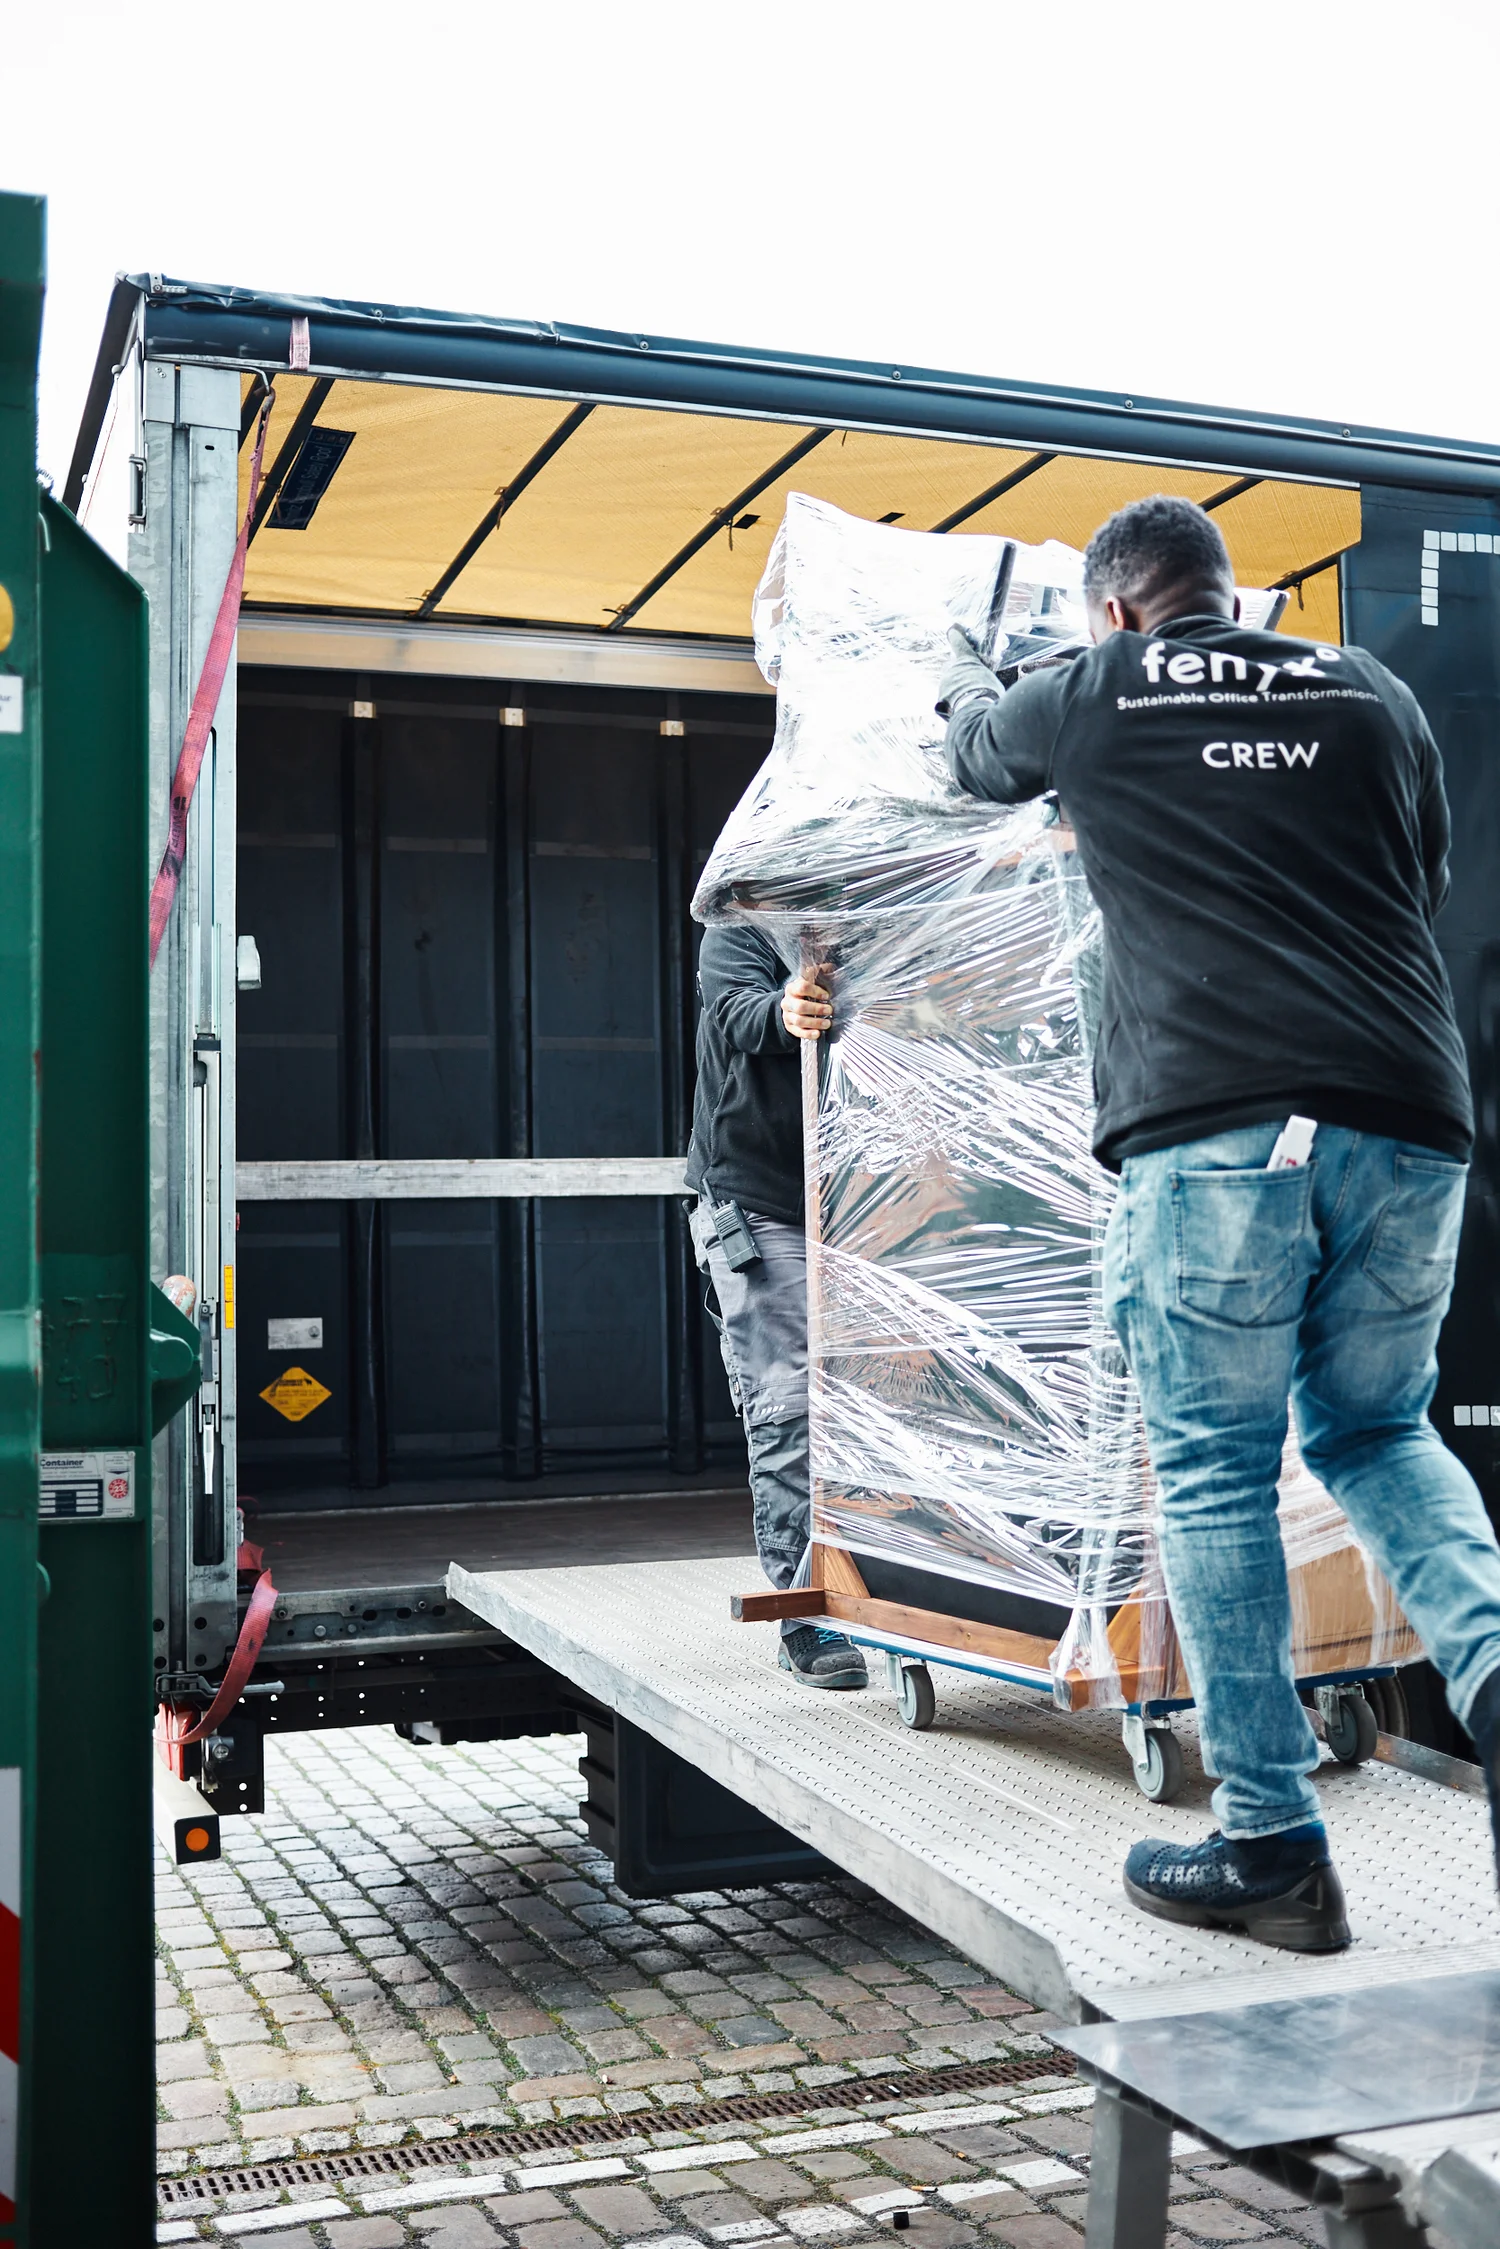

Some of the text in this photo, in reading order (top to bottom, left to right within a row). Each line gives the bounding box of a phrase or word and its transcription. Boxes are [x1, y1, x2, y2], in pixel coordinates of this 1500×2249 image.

[1117, 692, 1206, 710] Sustainable
[1208, 692, 1258, 704] Office
[1202, 741, 1319, 769] CREW
[40, 1458, 84, 1467] Container
